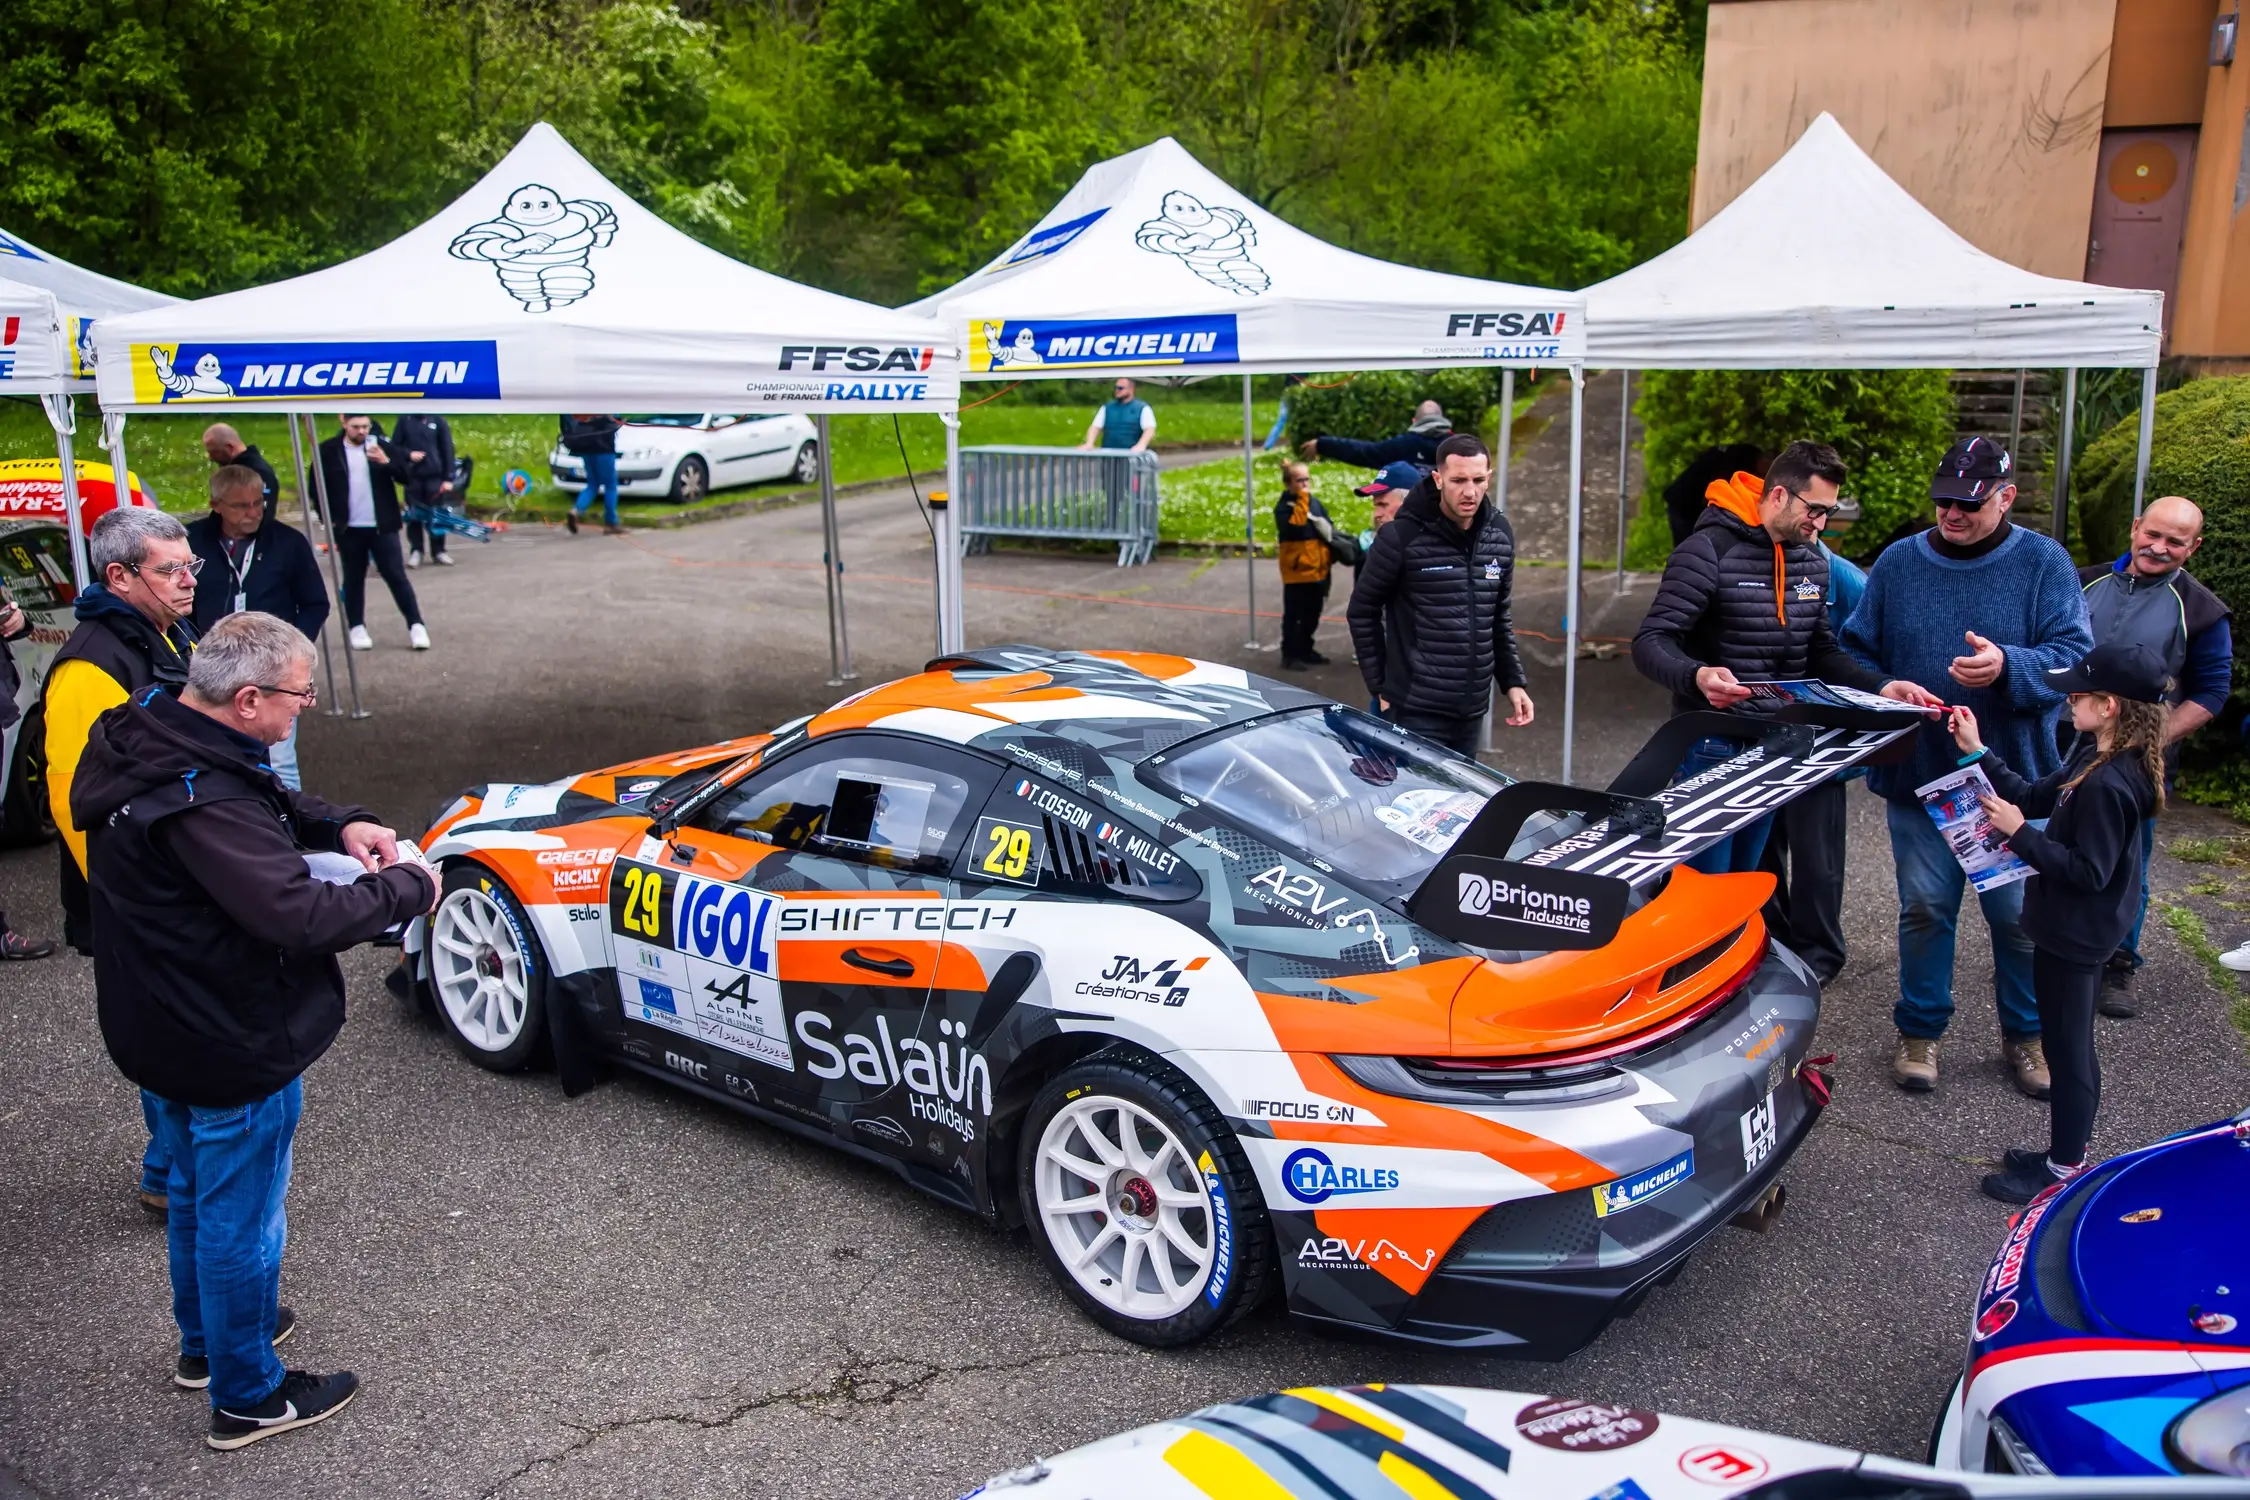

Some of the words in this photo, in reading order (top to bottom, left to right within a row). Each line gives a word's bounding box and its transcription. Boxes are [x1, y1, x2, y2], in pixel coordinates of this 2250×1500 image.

[1447, 313, 1552, 337] FFSA
[778, 346, 917, 371] FFSA
[1047, 332, 1217, 357] MICHELIN
[240, 361, 468, 387] MICHELIN
[746, 383, 825, 391] CHAMPIONNAT
[825, 383, 927, 401] RALLYE
[1004, 743, 1082, 781] PORSCHE
[1027, 784, 1093, 830] T.COSSON
[1087, 779, 1111, 796] Centres
[1111, 791, 1135, 808] Porsche
[1135, 803, 1166, 825] Bordeaux,
[1166, 818, 1175, 829] La
[1175, 823, 1204, 843] Rochelle
[1203, 837, 1211, 846] et
[1210, 841, 1241, 861] Bayonne
[1595, 729, 1899, 887] PORSCHE
[927, 827, 947, 840] spar
[1108, 826, 1121, 850] K.
[1125, 836, 1181, 875] MILLET
[1521, 834, 1586, 867] Bayon
[536, 849, 598, 864] ORECA
[983, 825, 1031, 878] 29
[553, 868, 601, 886] KICKLY
[1251, 865, 1349, 915] A2V
[569, 904, 600, 922] Stilo
[624, 867, 662, 937] 29
[1244, 885, 1330, 933] MECATRONIQUE
[1492, 880, 1590, 915] Brionne
[496, 897, 531, 967] MICHELIN
[677, 879, 769, 974] IGOL
[781, 908, 1017, 931] SHIFTECH
[1523, 907, 1590, 929] Industrie
[1101, 955, 1140, 983] JA
[1075, 982, 1161, 1003] Créations
[1165, 991, 1185, 1005] .fr
[652, 1010, 660, 1019] La
[660, 1012, 683, 1027] Région
[706, 1002, 764, 1025] ALPINE
[707, 1011, 725, 1022] STORE
[725, 1016, 765, 1034] VILLEFRANCHE
[1725, 1007, 1780, 1054] PORSCHE
[708, 1025, 790, 1060] Anselme
[795, 1010, 993, 1115] Salaün
[909, 1093, 975, 1143] Holidays
[1257, 1101, 1319, 1119] FOCUS
[1326, 1106, 1354, 1122] ON
[1281, 1148, 1399, 1204] CHARLES
[1632, 1159, 1687, 1197] MICHELIN
[2014, 1206, 2046, 1242] LONG
[1212, 1195, 1230, 1299] MICHELIN
[1298, 1238, 1366, 1261] A2V
[1299, 1262, 1371, 1270] MECATRONIQUE
[1996, 1240, 2028, 1291] HORN
